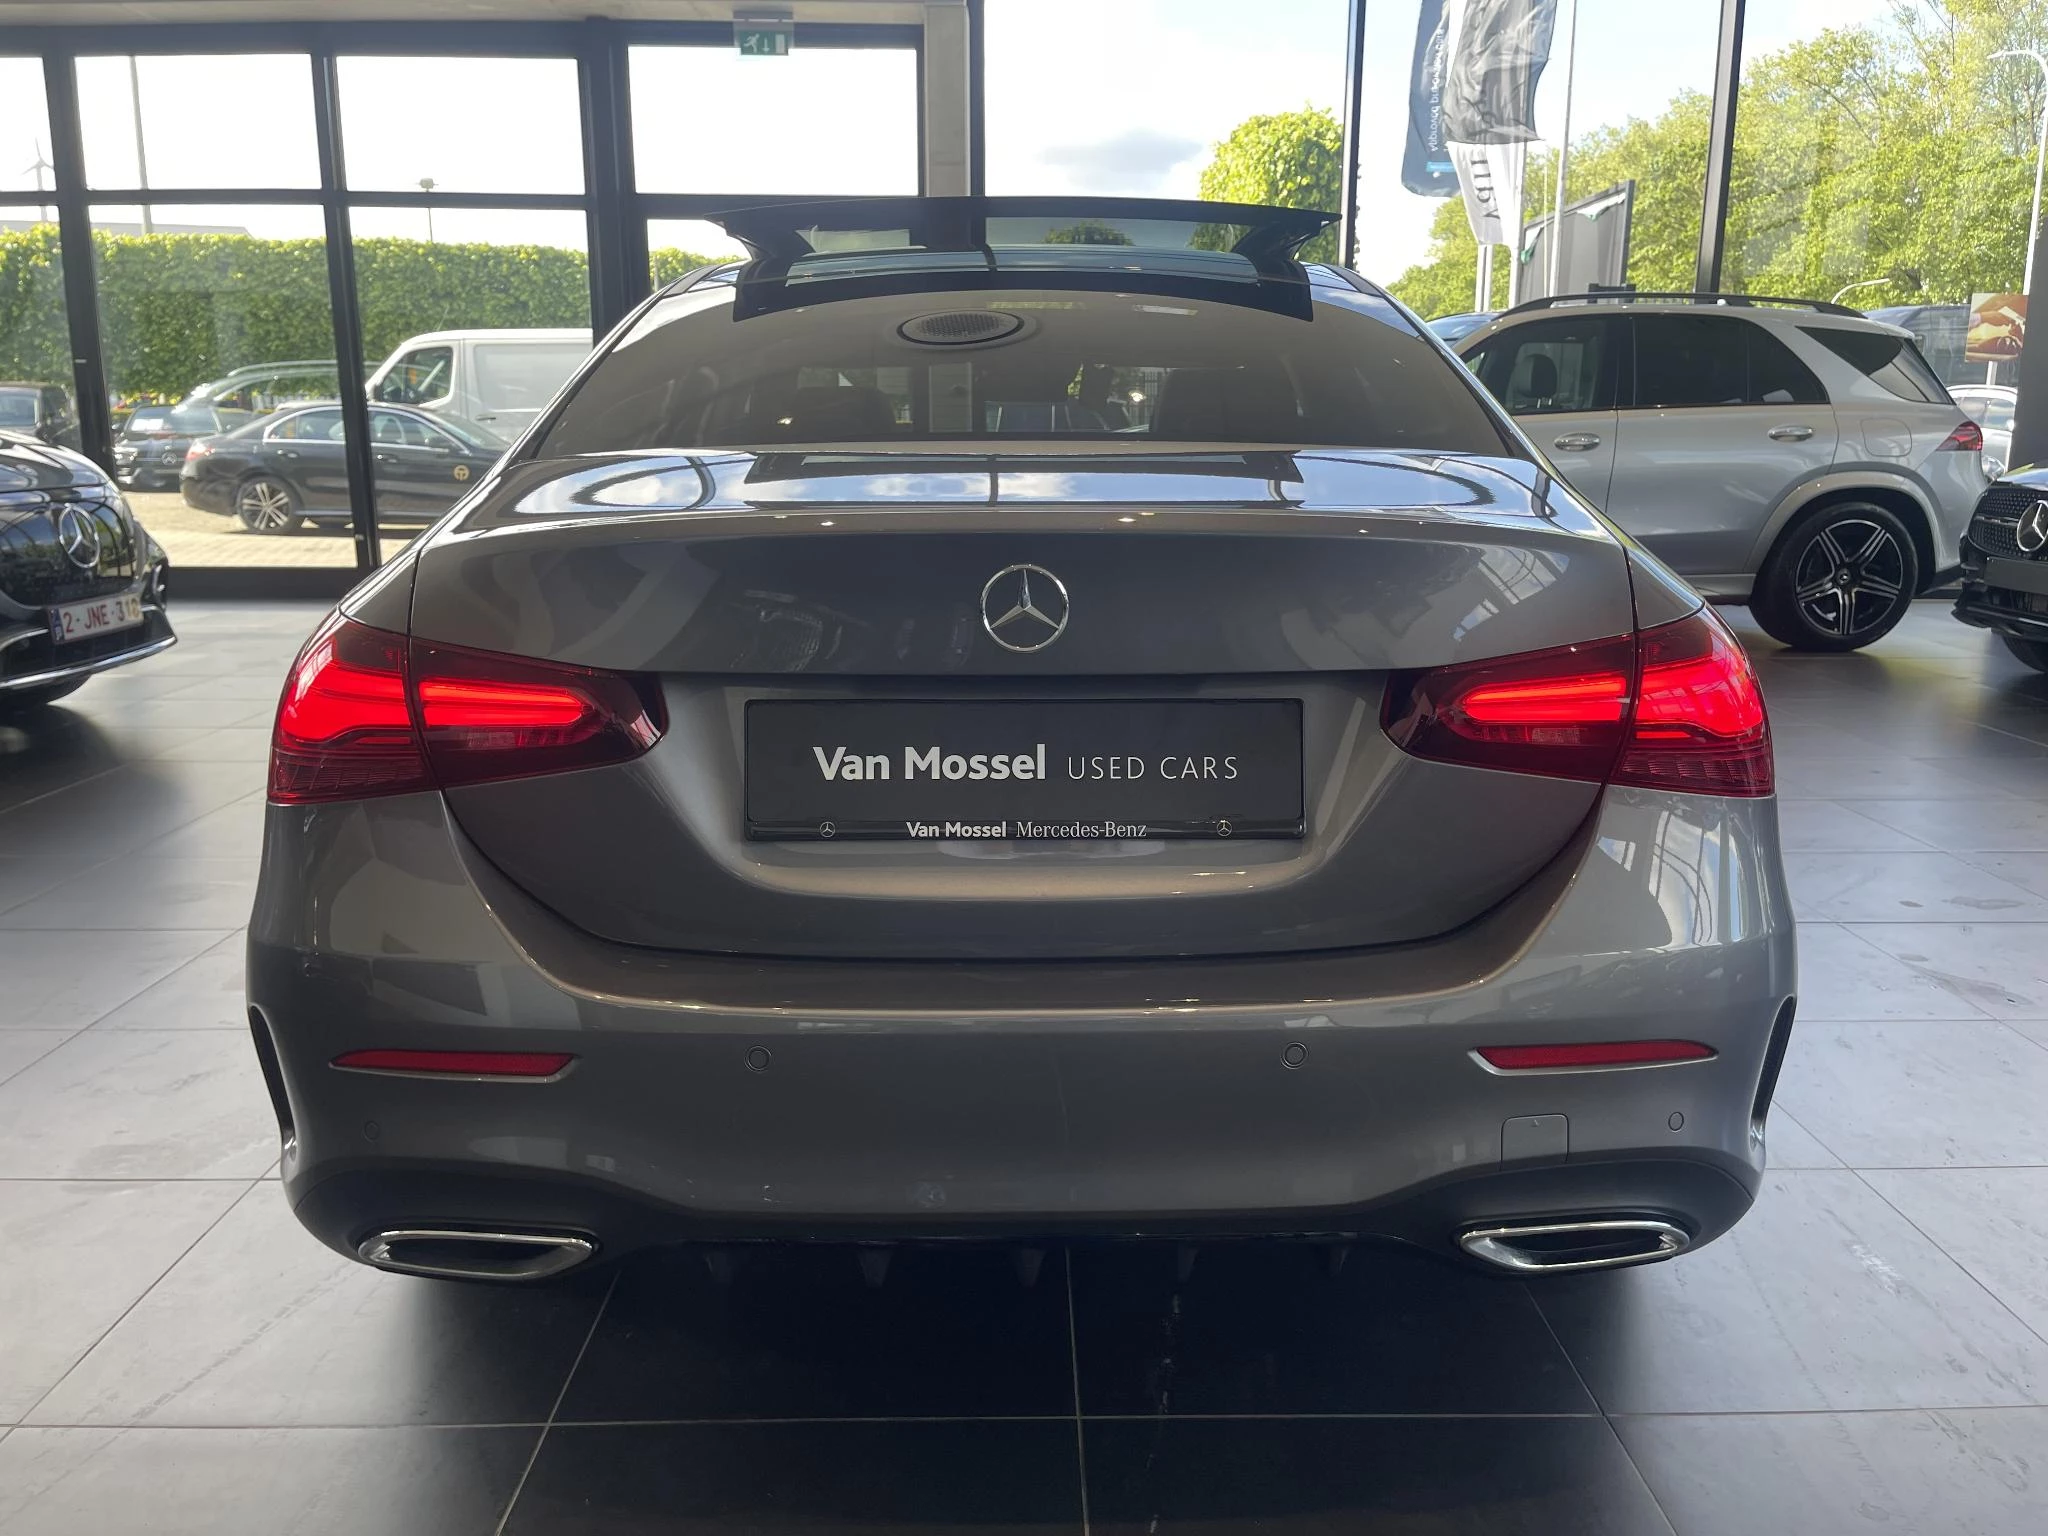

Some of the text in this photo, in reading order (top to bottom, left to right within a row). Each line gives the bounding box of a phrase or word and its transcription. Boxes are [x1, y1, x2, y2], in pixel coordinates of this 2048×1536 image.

[813, 744, 1238, 780] Van Mossel USED CARS
[906, 822, 1146, 837] Van Mossel Mercedes-Benz
